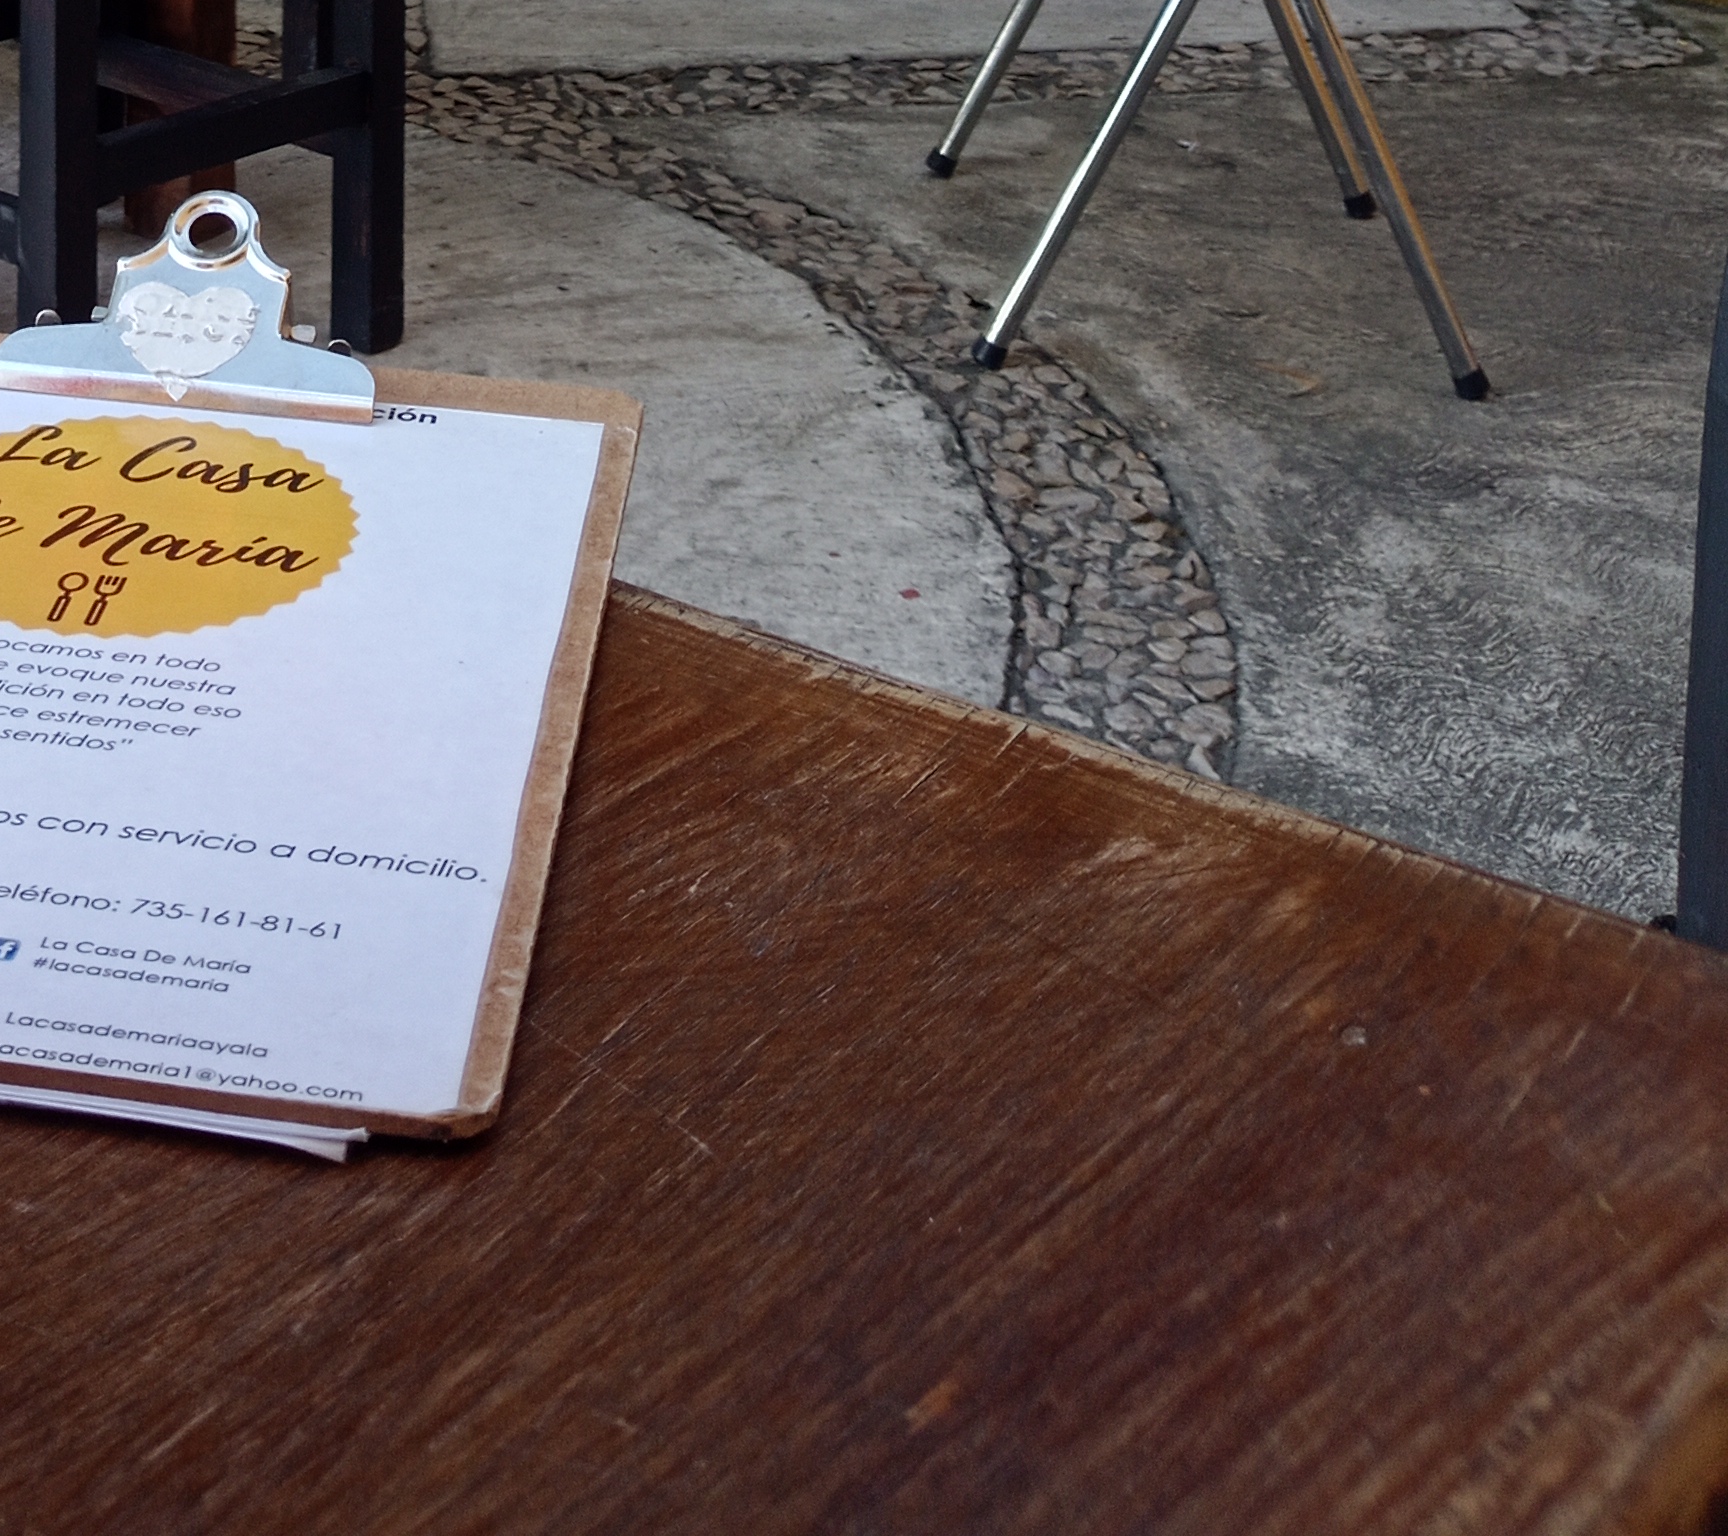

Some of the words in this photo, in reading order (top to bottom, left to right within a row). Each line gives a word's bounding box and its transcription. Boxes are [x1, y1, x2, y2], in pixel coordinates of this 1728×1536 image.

[120, 436, 324, 493] Casa
[40, 505, 319, 573] María
[17, 663, 124, 683] evoque
[131, 676, 236, 696] nuestra
[111, 651, 147, 665] en
[155, 654, 221, 672] todo
[37, 708, 202, 737] estremecer
[73, 691, 109, 705] en
[118, 693, 185, 713] todo
[193, 705, 242, 719] eso
[37, 816, 109, 837] con
[118, 826, 257, 853] servicio
[270, 844, 296, 858] a
[308, 846, 487, 883] domicilio.
[129, 898, 342, 939] 735-161-81-61
[40, 936, 68, 950] La
[76, 941, 136, 959] Casa
[143, 949, 176, 964] De
[183, 955, 251, 974] María
[33, 957, 230, 993] #lacasademaria
[5, 1011, 268, 1058] Lacasademariaayala
